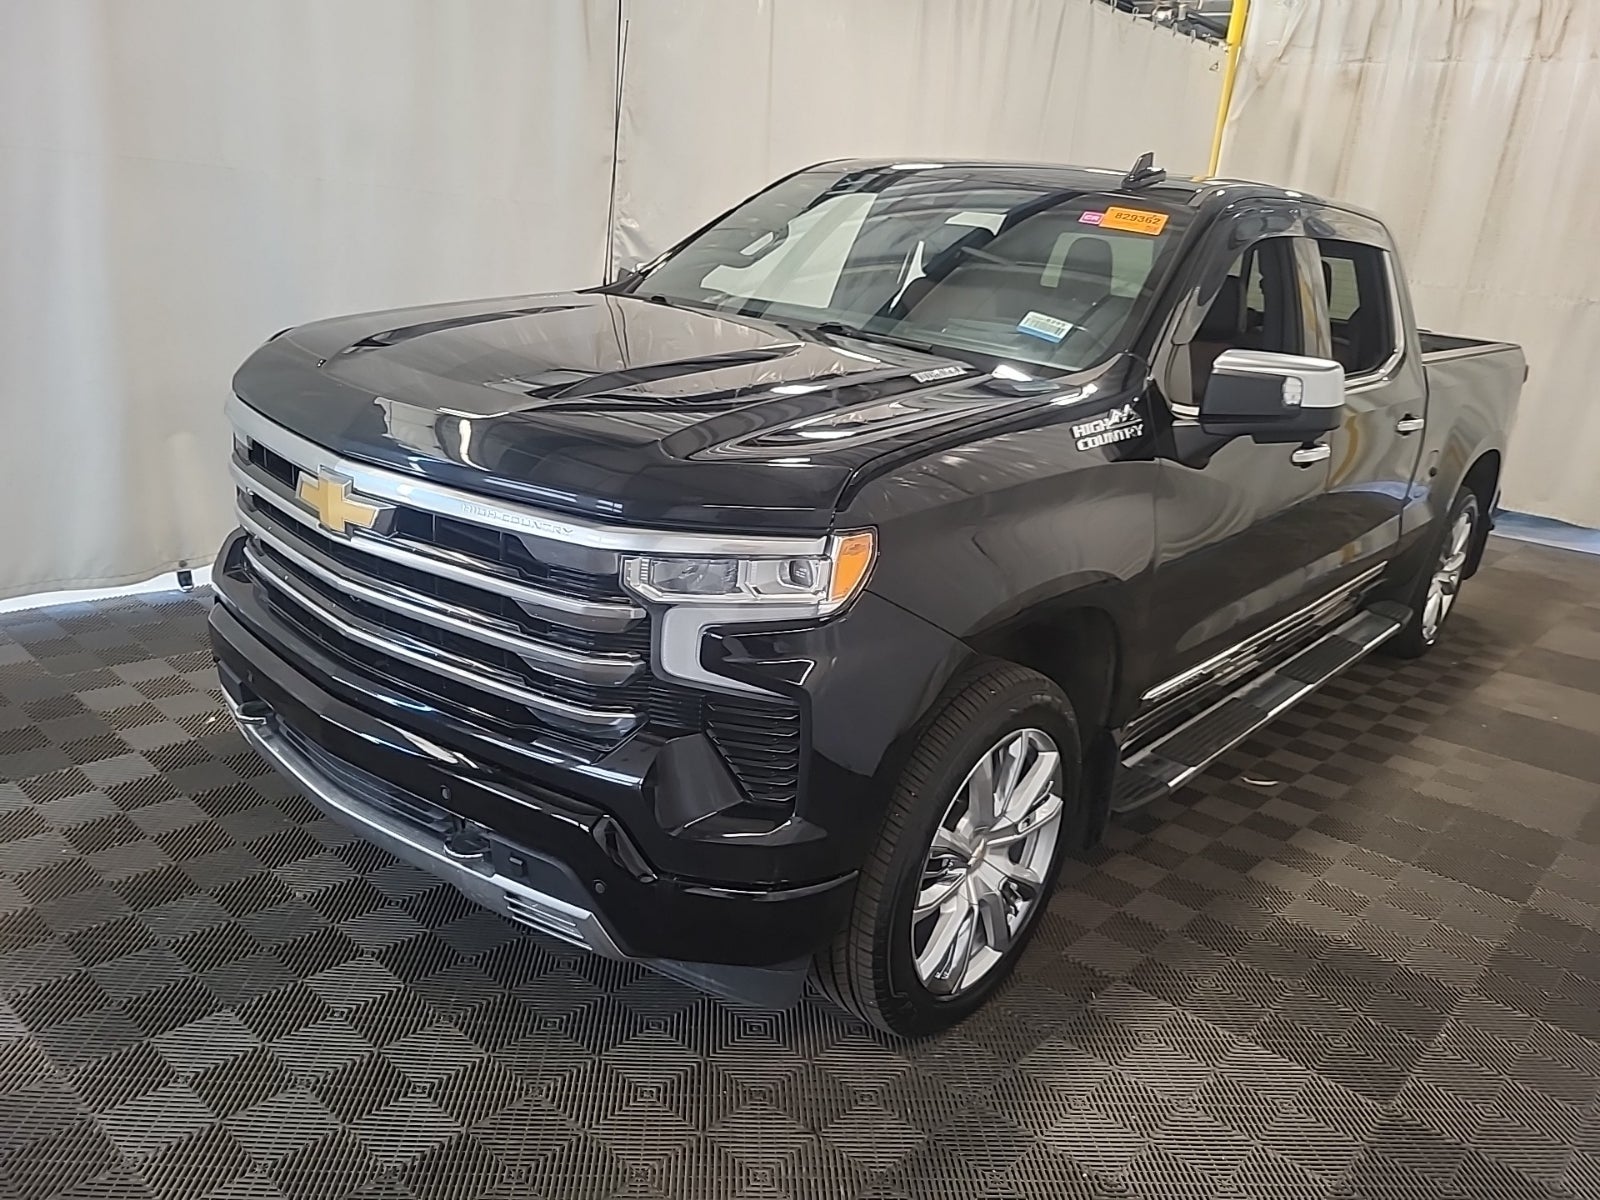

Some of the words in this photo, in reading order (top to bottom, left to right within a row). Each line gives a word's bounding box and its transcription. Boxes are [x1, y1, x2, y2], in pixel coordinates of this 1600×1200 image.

[1114, 211, 1162, 226] 829362
[1072, 419, 1109, 438] HIGH
[1076, 423, 1144, 451] COUNTRY
[462, 503, 497, 519] HIGH
[502, 514, 574, 536] COUNTRY
